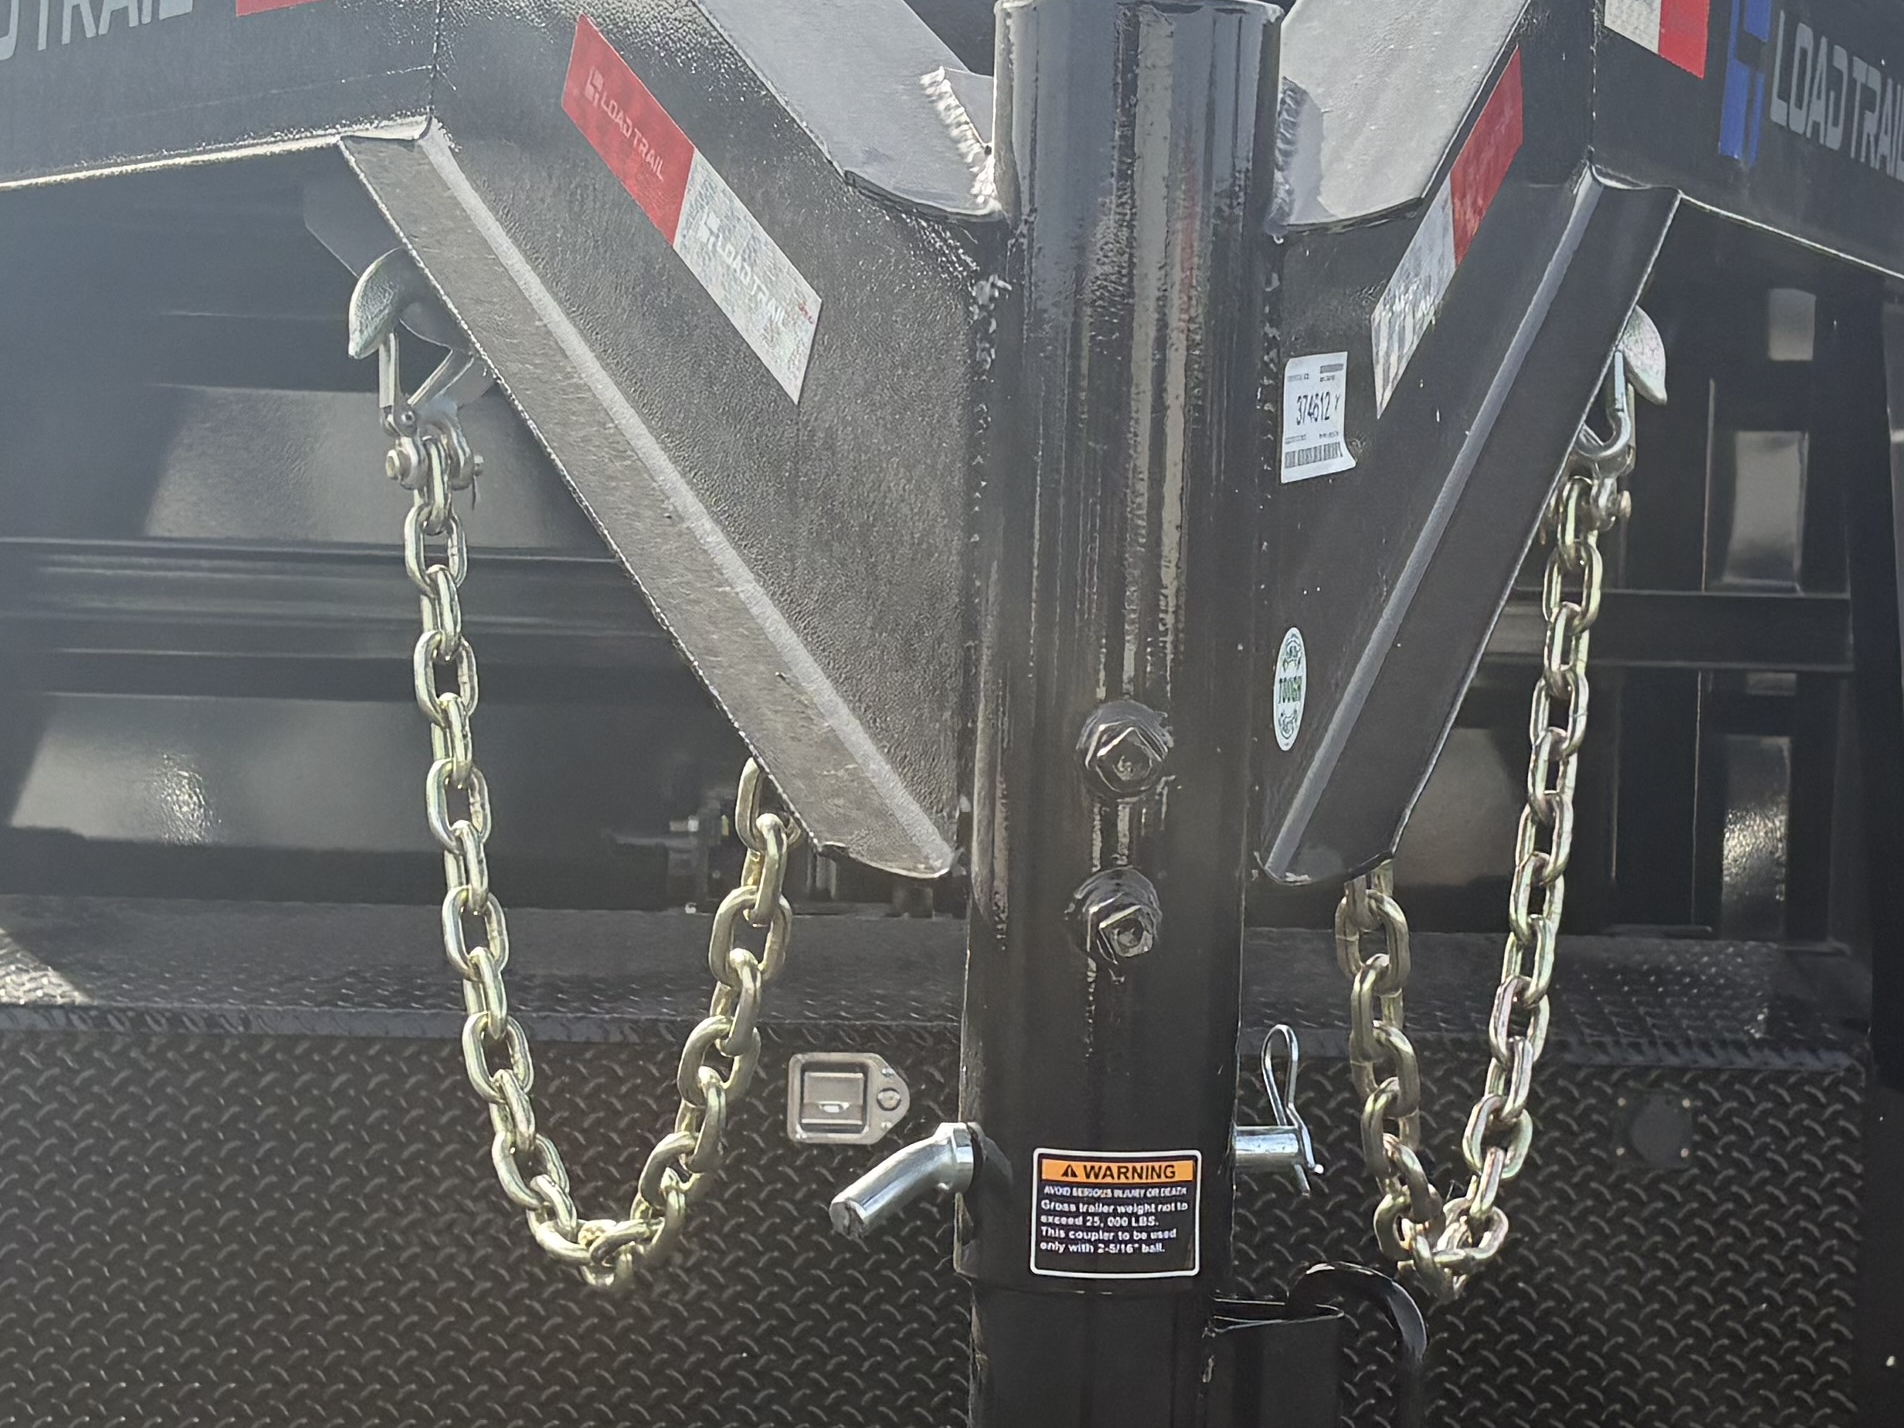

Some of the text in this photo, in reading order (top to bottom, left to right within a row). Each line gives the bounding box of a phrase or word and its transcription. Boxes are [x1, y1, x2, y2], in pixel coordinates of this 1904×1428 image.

[1770, 9, 1848, 151] LOAD
[600, 89, 664, 181] LOAD TRAIL
[1083, 1164, 1176, 1181] WARNING
[1041, 1199, 1076, 1212] Gross
[1079, 1200, 1114, 1213] trailer
[1116, 1202, 1156, 1215] weight
[1040, 1215, 1083, 1226] exceed
[1041, 1227, 1177, 1242] This coupler to be used
[1040, 1241, 1066, 1254] only
[1068, 1243, 1094, 1253] with
